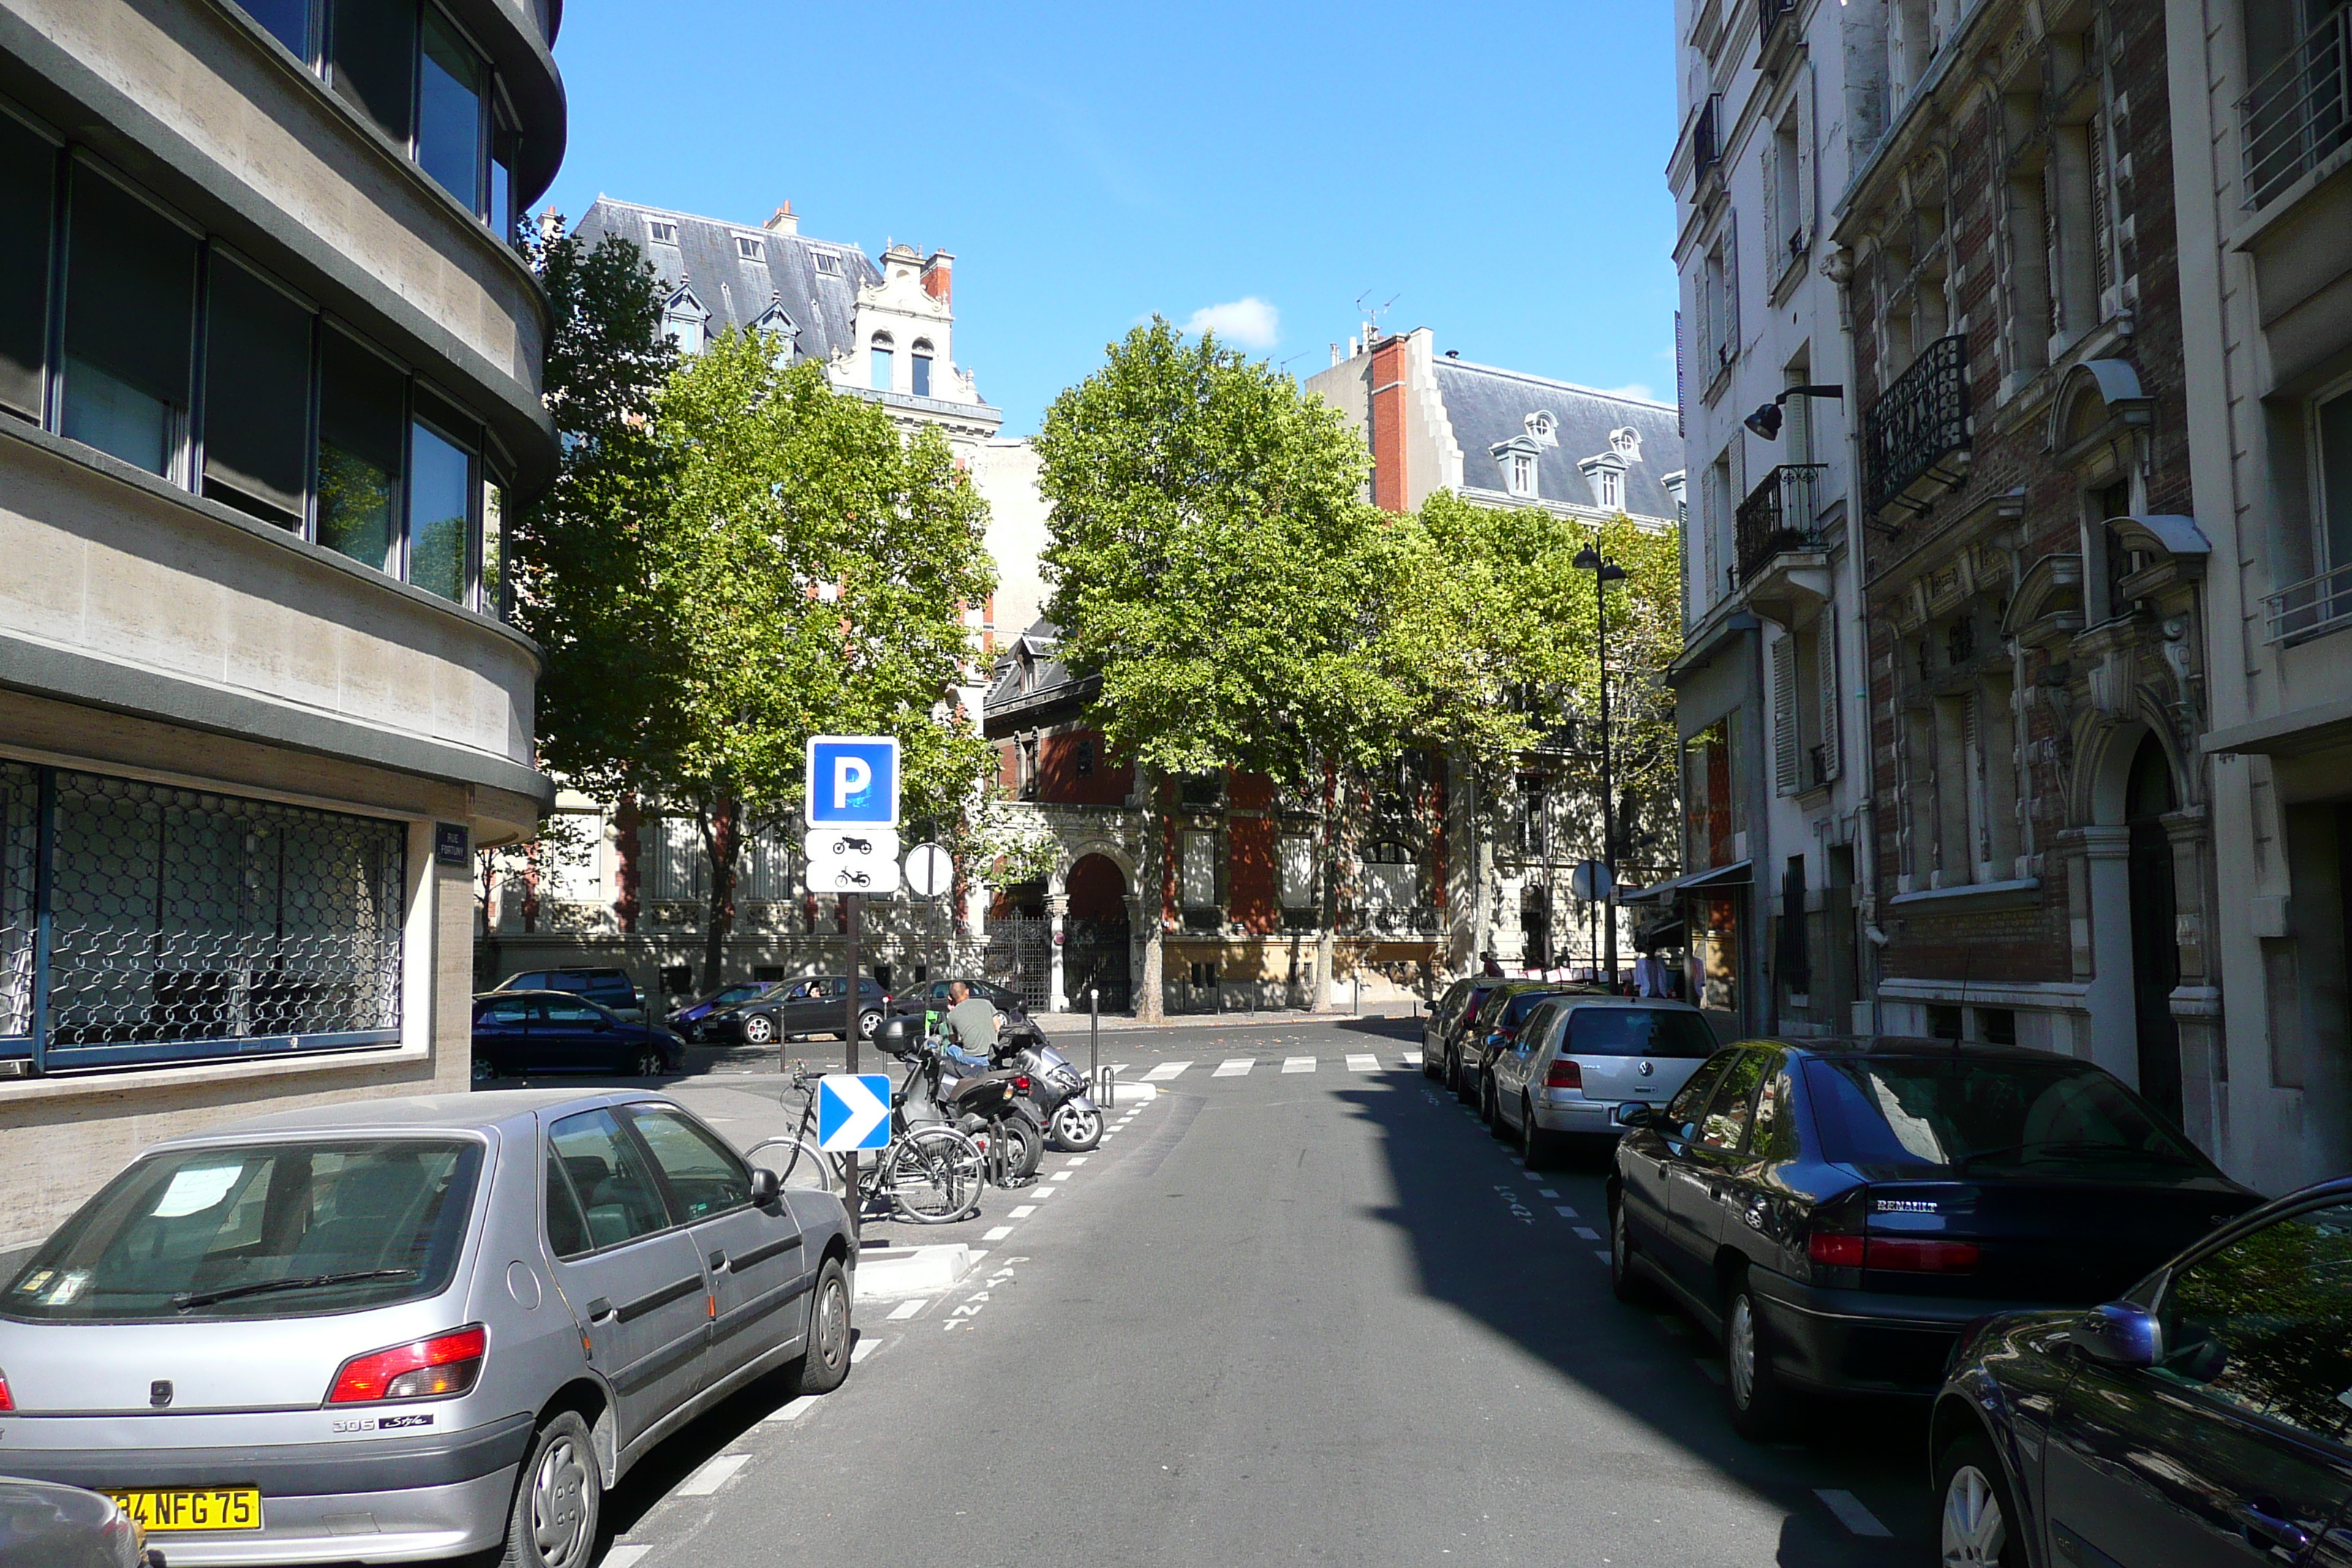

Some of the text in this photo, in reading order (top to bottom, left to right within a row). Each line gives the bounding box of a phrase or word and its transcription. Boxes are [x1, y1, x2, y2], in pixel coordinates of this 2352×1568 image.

[834, 756, 872, 808] P
[447, 832, 459, 843] RUE
[441, 844, 463, 856] FORTUNY
[1877, 1199, 1937, 1213] RENAULT
[942, 1256, 1030, 1330] PAYANT
[333, 1415, 427, 1433] 306 Style
[155, 1493, 208, 1525] NFG
[215, 1493, 249, 1523] 75
